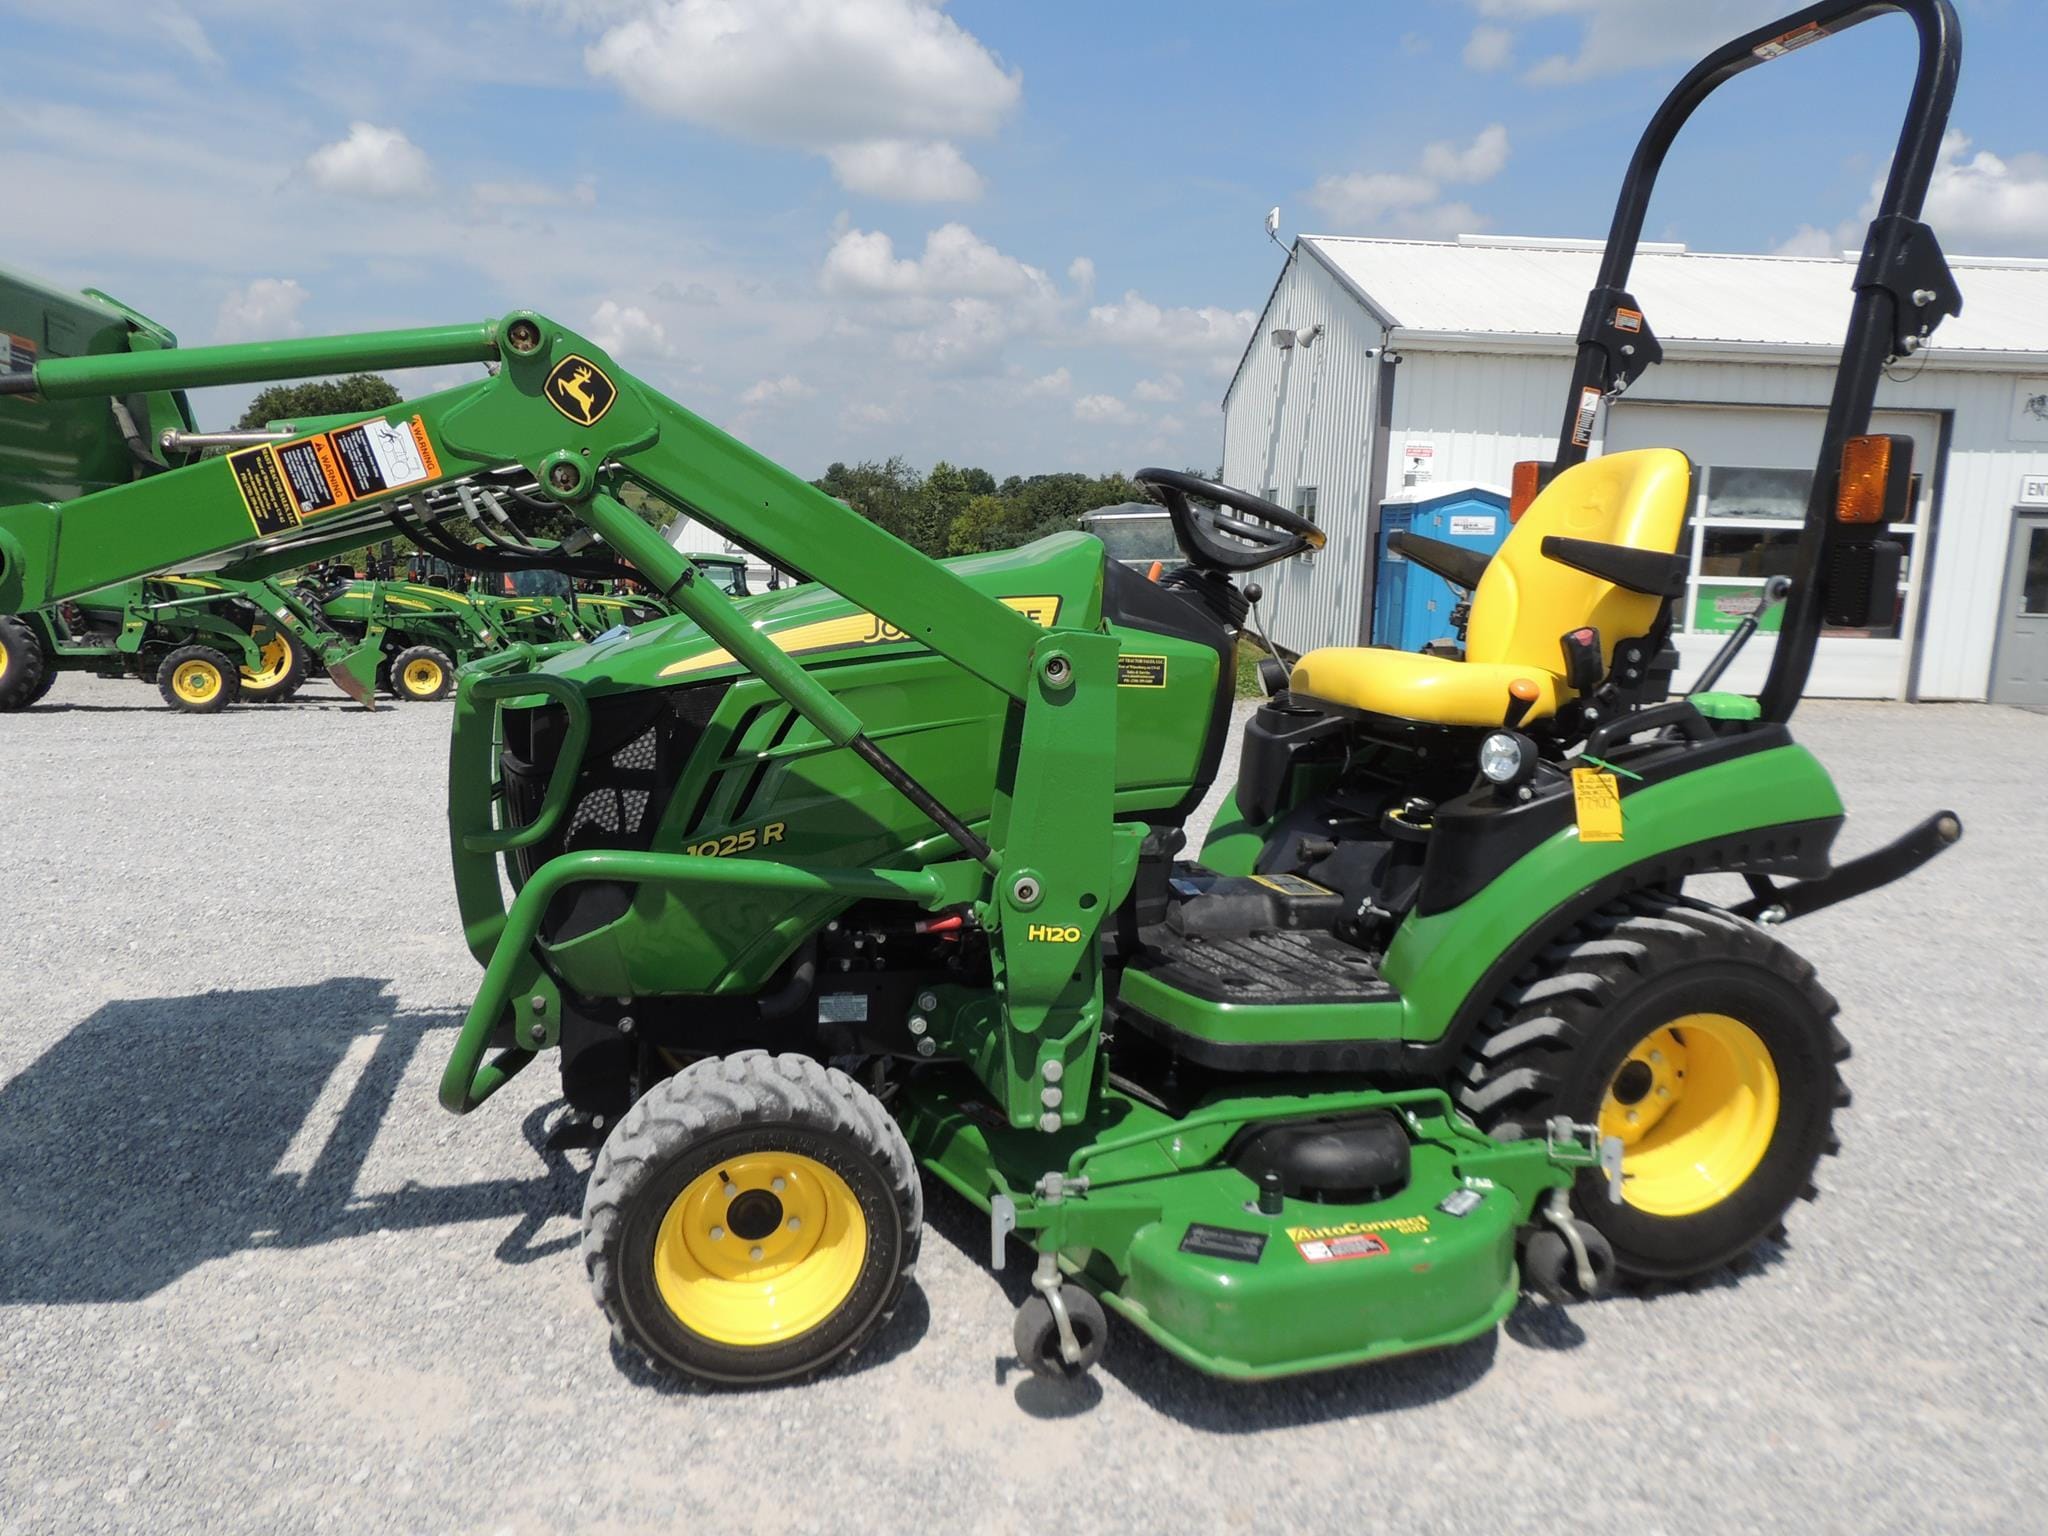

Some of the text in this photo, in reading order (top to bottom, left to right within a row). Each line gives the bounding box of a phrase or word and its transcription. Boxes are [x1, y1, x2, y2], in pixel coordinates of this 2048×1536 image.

[412, 427, 435, 470] WARNING
[261, 447, 273, 465] MAST
[267, 464, 283, 493] TRACTOR
[285, 512, 296, 525] LLC
[320, 454, 343, 498] WARNING
[687, 822, 786, 857] 1025 R
[1027, 923, 1081, 943] H120
[1288, 1215, 1430, 1242] AutoConnect
